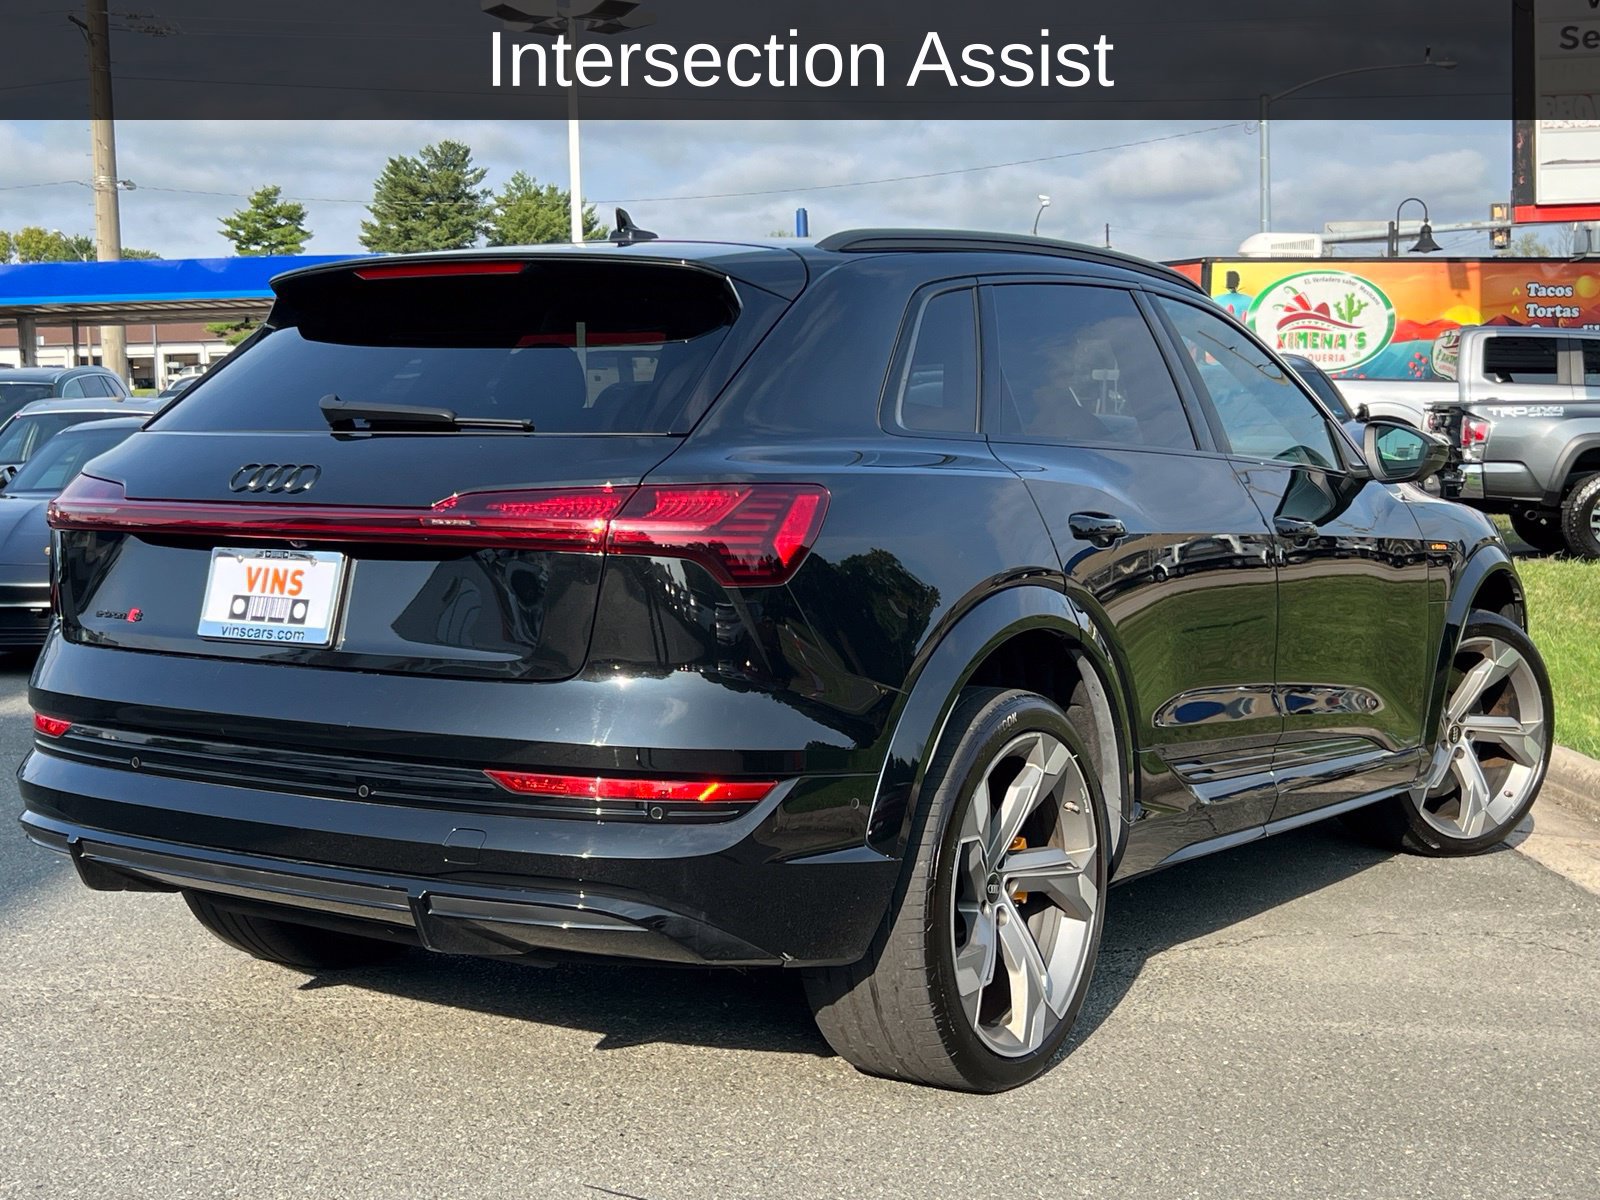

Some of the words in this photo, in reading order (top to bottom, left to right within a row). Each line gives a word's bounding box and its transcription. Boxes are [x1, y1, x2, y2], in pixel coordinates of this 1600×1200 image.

[1527, 283, 1573, 297] Tacos
[1526, 304, 1580, 318] Tortas
[1276, 332, 1367, 350] XIMENA'S
[1307, 353, 1345, 362] QUERIA
[1487, 407, 1527, 417] TRD
[246, 566, 305, 596] VINS
[221, 624, 305, 641] vinscars.com
